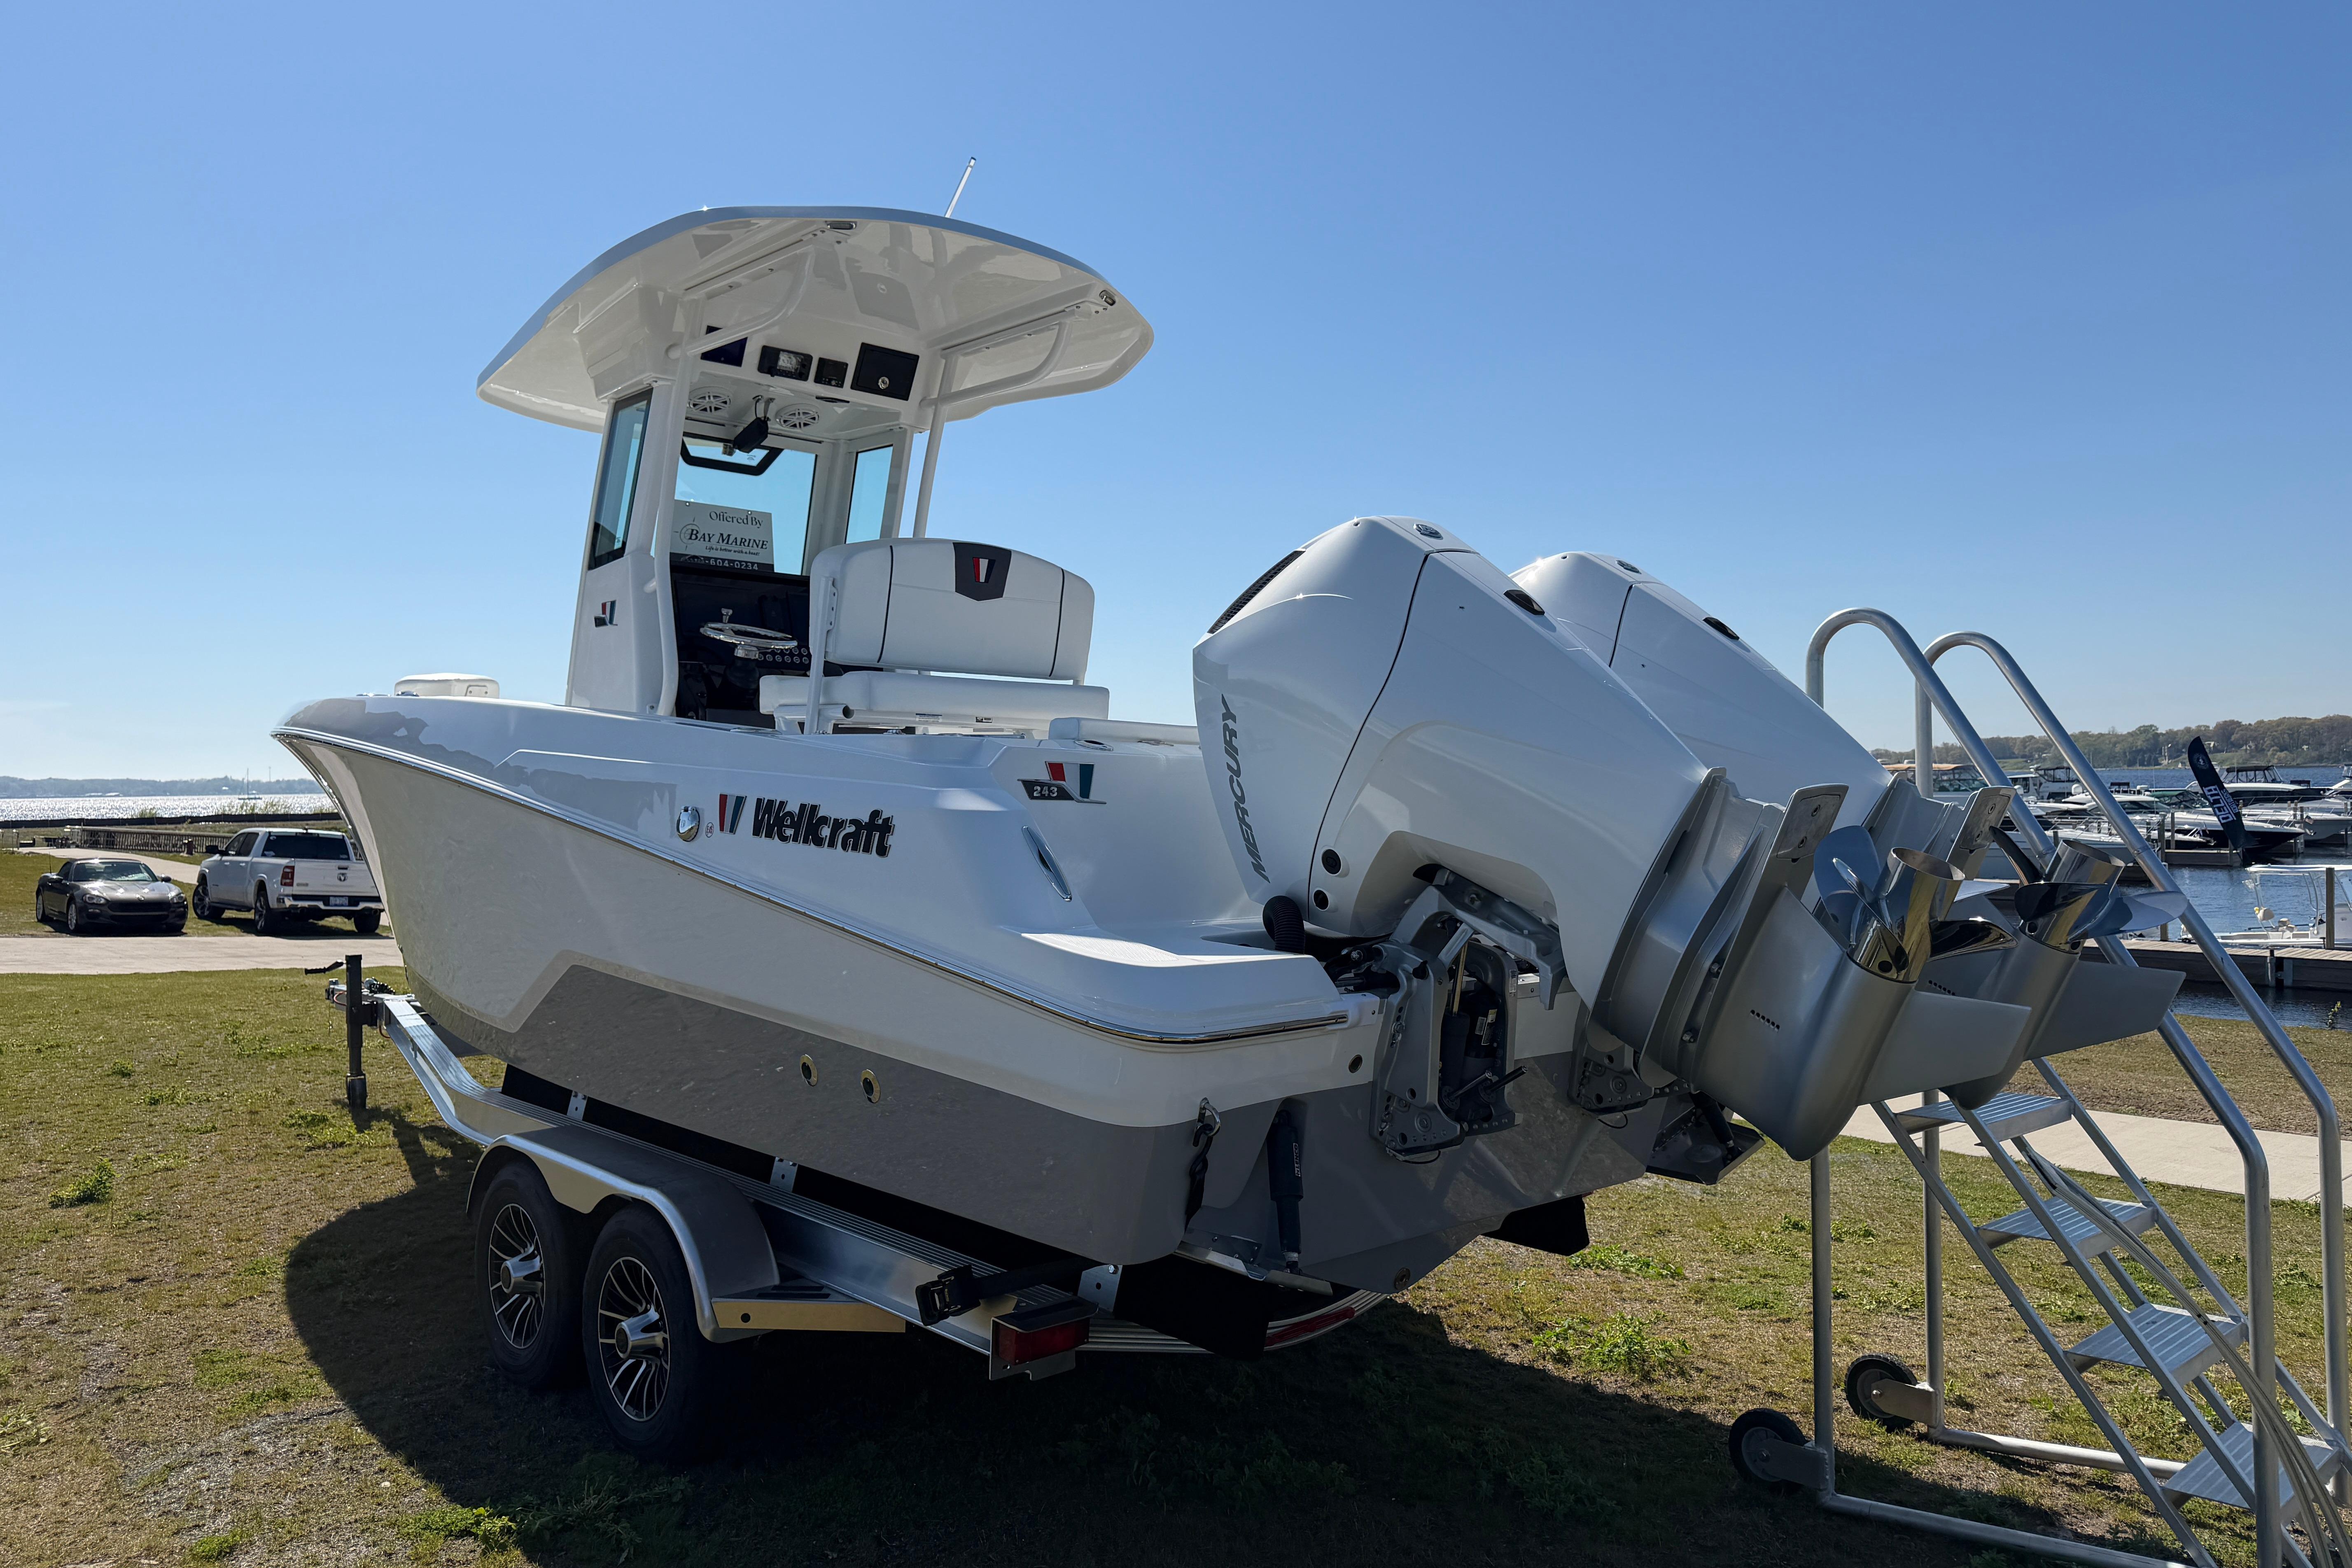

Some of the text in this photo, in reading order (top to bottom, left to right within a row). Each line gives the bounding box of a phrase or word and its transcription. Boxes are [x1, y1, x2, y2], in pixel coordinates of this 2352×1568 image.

[709, 511, 763, 529] Offered By
[688, 529, 768, 549] BAY MARINE
[684, 556, 758, 570] -604-0234
[1033, 786, 1058, 797] 243
[1221, 693, 1270, 884] MERCURY
[2203, 785, 2233, 823] DELTA
[752, 797, 895, 858] Wellcraft
